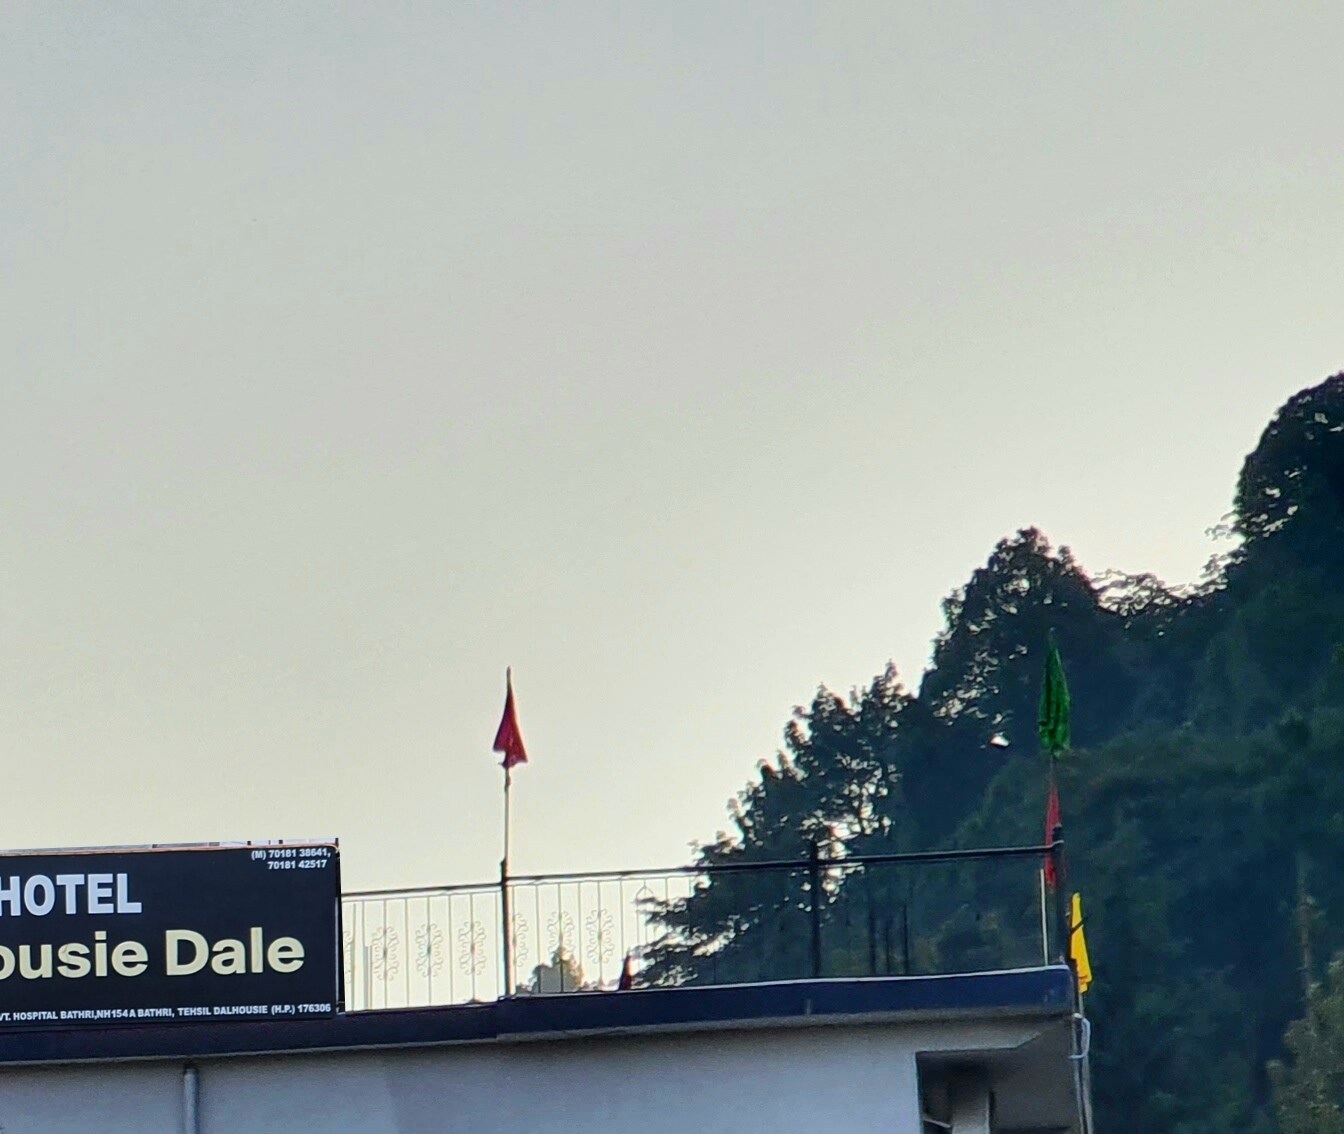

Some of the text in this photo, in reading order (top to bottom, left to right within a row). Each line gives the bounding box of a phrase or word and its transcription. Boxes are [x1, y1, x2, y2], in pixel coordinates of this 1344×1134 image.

[251, 850, 267, 861] (M)
[268, 849, 297, 859] 70181
[268, 859, 327, 870] 70181 42517
[165, 926, 305, 976] Dale
[13, 1010, 59, 1022] HOSPITAL
[137, 1007, 175, 1018] BATHRI,
[176, 1006, 212, 1017] TEHSIL
[213, 1004, 269, 1016] DALHOUSIE
[270, 1004, 296, 1016] (H.P.)
[297, 1002, 332, 1013] 176306
